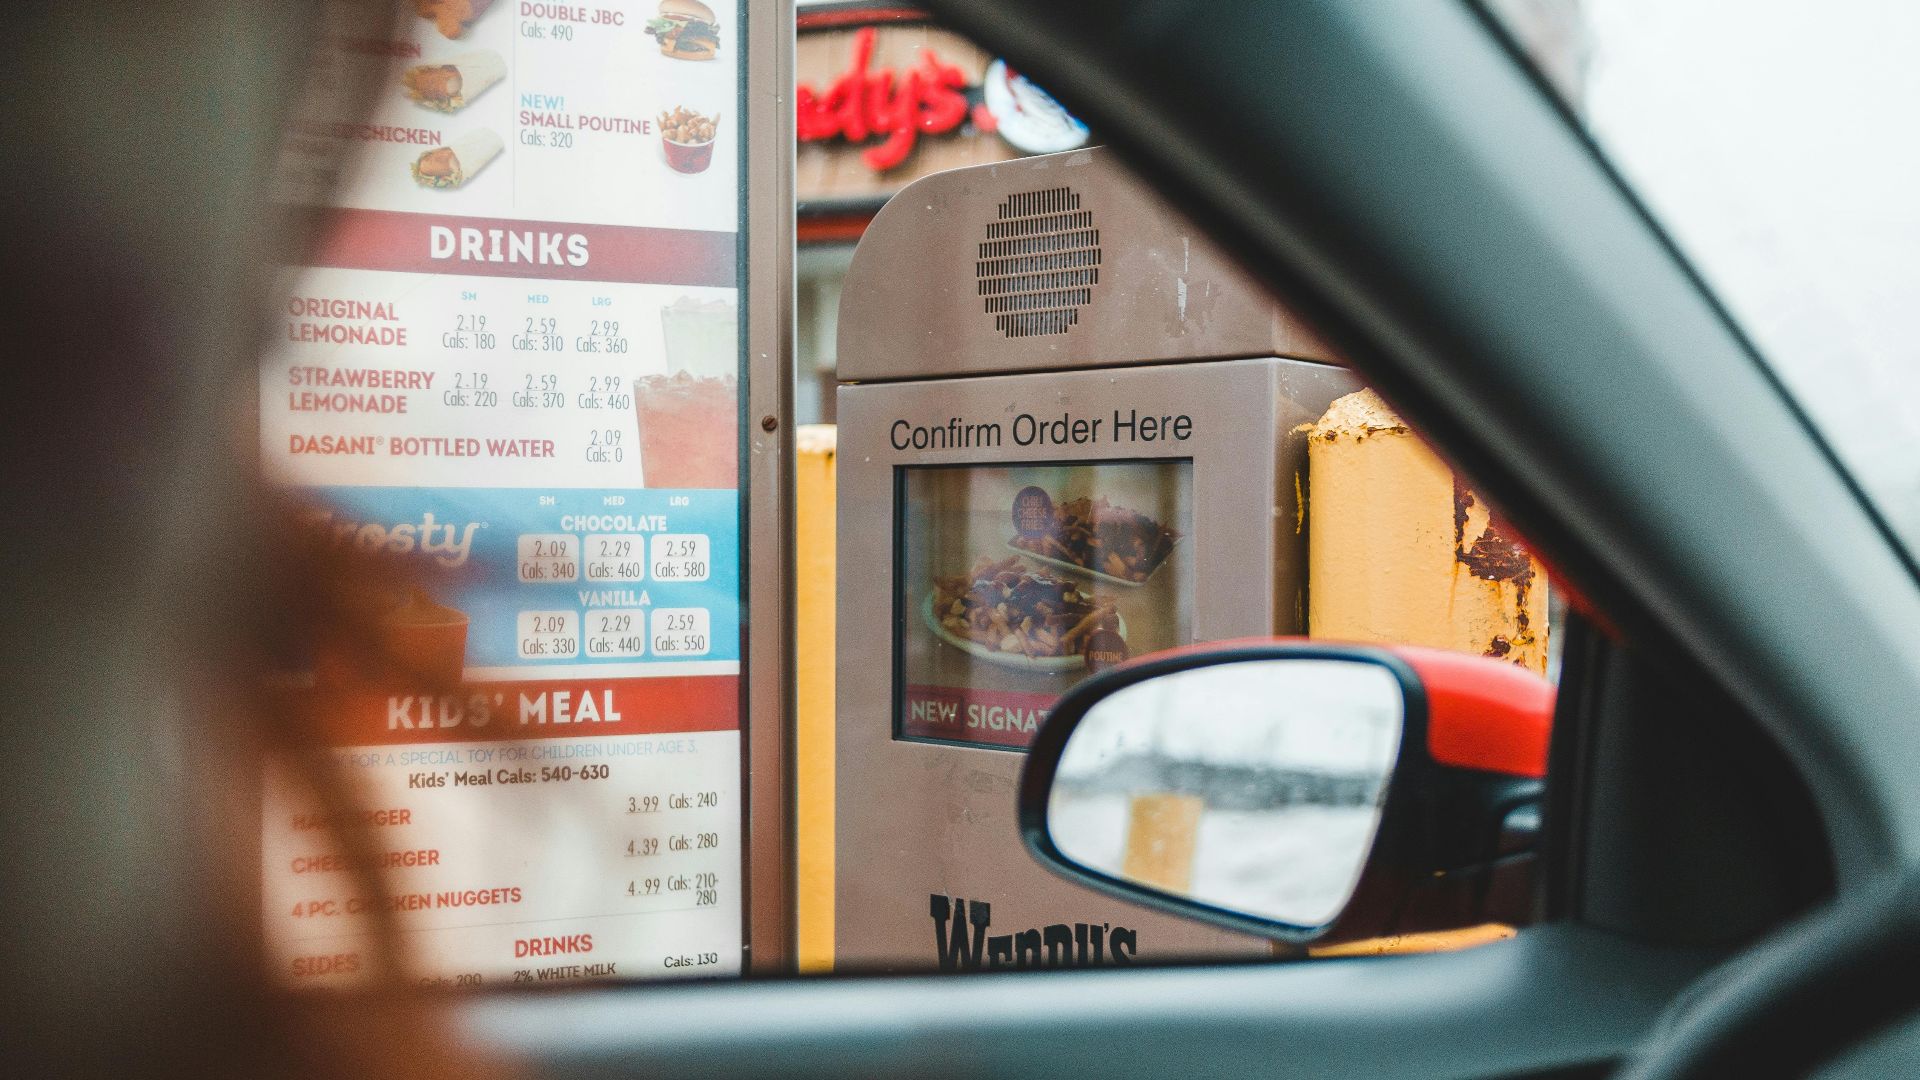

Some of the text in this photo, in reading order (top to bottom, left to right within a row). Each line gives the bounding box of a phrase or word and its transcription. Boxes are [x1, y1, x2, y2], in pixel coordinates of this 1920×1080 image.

[520, 2, 624, 26] DOUBLE JBC
[521, 21, 573, 41] Cals: 490
[521, 93, 564, 110] NEW!
[520, 110, 650, 135] SMALL POUTINE
[520, 129, 573, 148] Cals: 320
[430, 225, 589, 267] DRINKS
[462, 291, 612, 306] SM MED LRG
[288, 297, 399, 321] ORIGINAL
[288, 323, 407, 346] LEMONADE
[457, 315, 619, 337] 2.19 2.59 2.99
[443, 332, 496, 350] Cals: 180
[512, 334, 564, 352] Cals: 310
[576, 336, 628, 354] Cals: 360
[289, 366, 435, 389] STRAWBERRY
[455, 372, 620, 392] 2.19 2.59 2.99
[289, 392, 407, 414] LEMONADE
[444, 391, 497, 407] Cals: 220
[512, 391, 565, 409] Cals: 370
[578, 393, 630, 410] Cals: 460
[591, 429, 621, 446] 2.09
[890, 409, 1193, 450] Confirm Order Here
[390, 437, 481, 457] BOTTLED
[487, 439, 555, 458] WATER
[586, 446, 623, 463] Cals: 0
[539, 496, 689, 506] SM MED LRG
[561, 515, 667, 532] CHOCOLATE
[535, 541, 696, 557] 2.09 2.29 2.59
[522, 562, 575, 579] Cals: 340
[589, 562, 640, 578] Cals: 460
[655, 562, 705, 578] Cals: 580
[578, 590, 651, 607] VANILLA
[533, 614, 694, 633] 2.09 2.29 2.59
[522, 638, 575, 655] Cals: 330
[589, 636, 641, 653] Cals: 440
[655, 635, 705, 652] Cals: 550
[387, 689, 621, 730] KIDS' MEAL
[910, 700, 959, 724] NEW
[385, 752, 395, 766] A
[400, 750, 463, 766] SPECIAL
[467, 748, 495, 764] TOY
[500, 747, 527, 762] FOR
[532, 743, 602, 760] CHILDREN
[606, 741, 652, 757] UNDER
[656, 740, 684, 754] AGE
[409, 764, 610, 789] Kids' Meal Cals: 540-630
[628, 792, 718, 813] 3.99 Cals: 240
[628, 832, 718, 856] 4.39 Cals: 280
[628, 872, 719, 896] 4.99 Cals: 210-
[291, 902, 302, 917] 4
[309, 900, 340, 918] PC.
[436, 887, 522, 908] NUGGETS
[696, 889, 717, 906] 280
[514, 934, 593, 959] DRINKS
[291, 953, 360, 978] SIDES
[663, 952, 718, 968] Cals: 130
[456, 973, 482, 987] 200
[513, 962, 616, 984] 2% WHITE MILK
